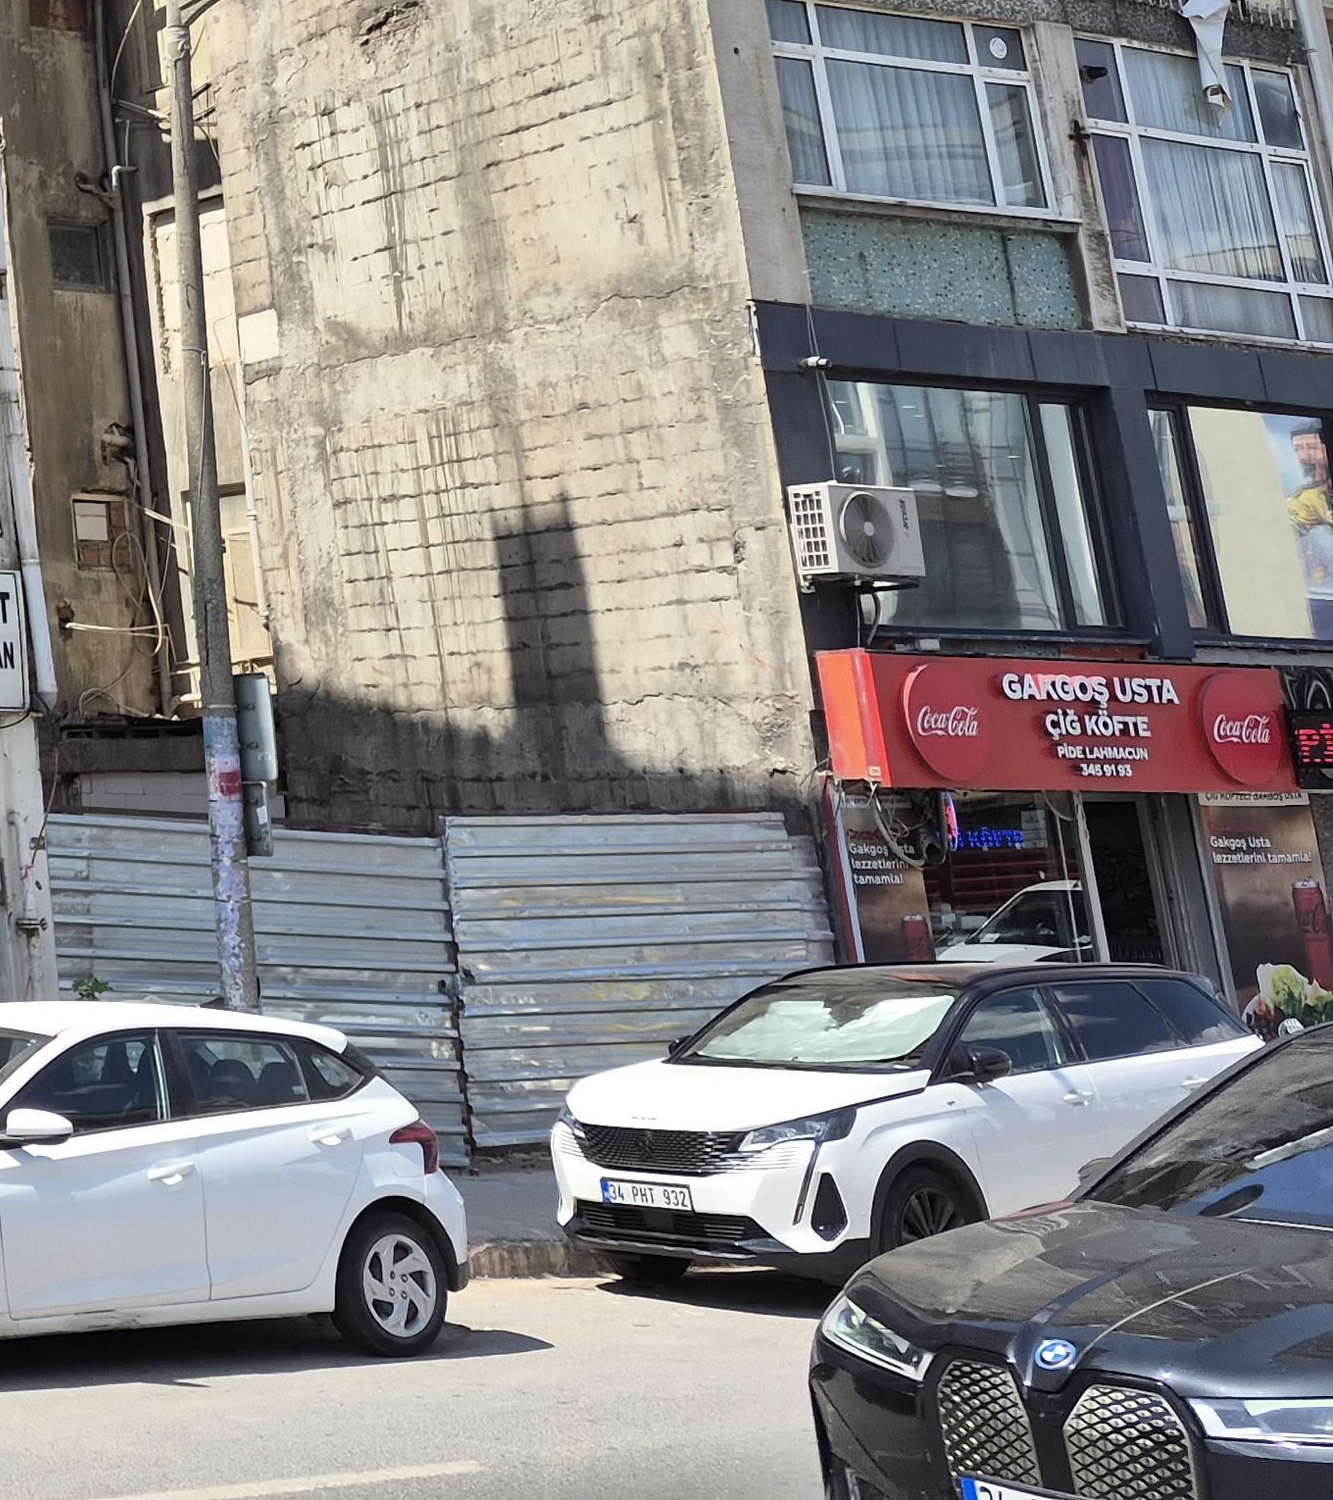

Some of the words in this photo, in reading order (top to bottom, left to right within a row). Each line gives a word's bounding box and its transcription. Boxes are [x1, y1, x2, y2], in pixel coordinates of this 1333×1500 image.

[1002, 672, 1109, 708] GAKGOŞ
[1115, 677, 1179, 705] USTA
[1045, 709, 1083, 740] ÇİĞ
[1086, 707, 1151, 737] KÖFTE
[1057, 742, 1085, 759] PİDE
[1086, 747, 1149, 761] LAHMACUN
[1081, 763, 1102, 777] 345
[1103, 764, 1116, 777] 91
[1117, 765, 1132, 777] 93
[850, 843, 888, 857] Gakgoş
[1210, 836, 1247, 850] Gakgoş
[1248, 836, 1272, 848] Usta
[1213, 851, 1266, 864] lezzetlerini
[1267, 851, 1313, 863] tamamla!
[854, 874, 903, 885] tamamla!
[609, 1184, 624, 1199] 34
[632, 1187, 655, 1204] PHT
[663, 1190, 688, 1207] 932
